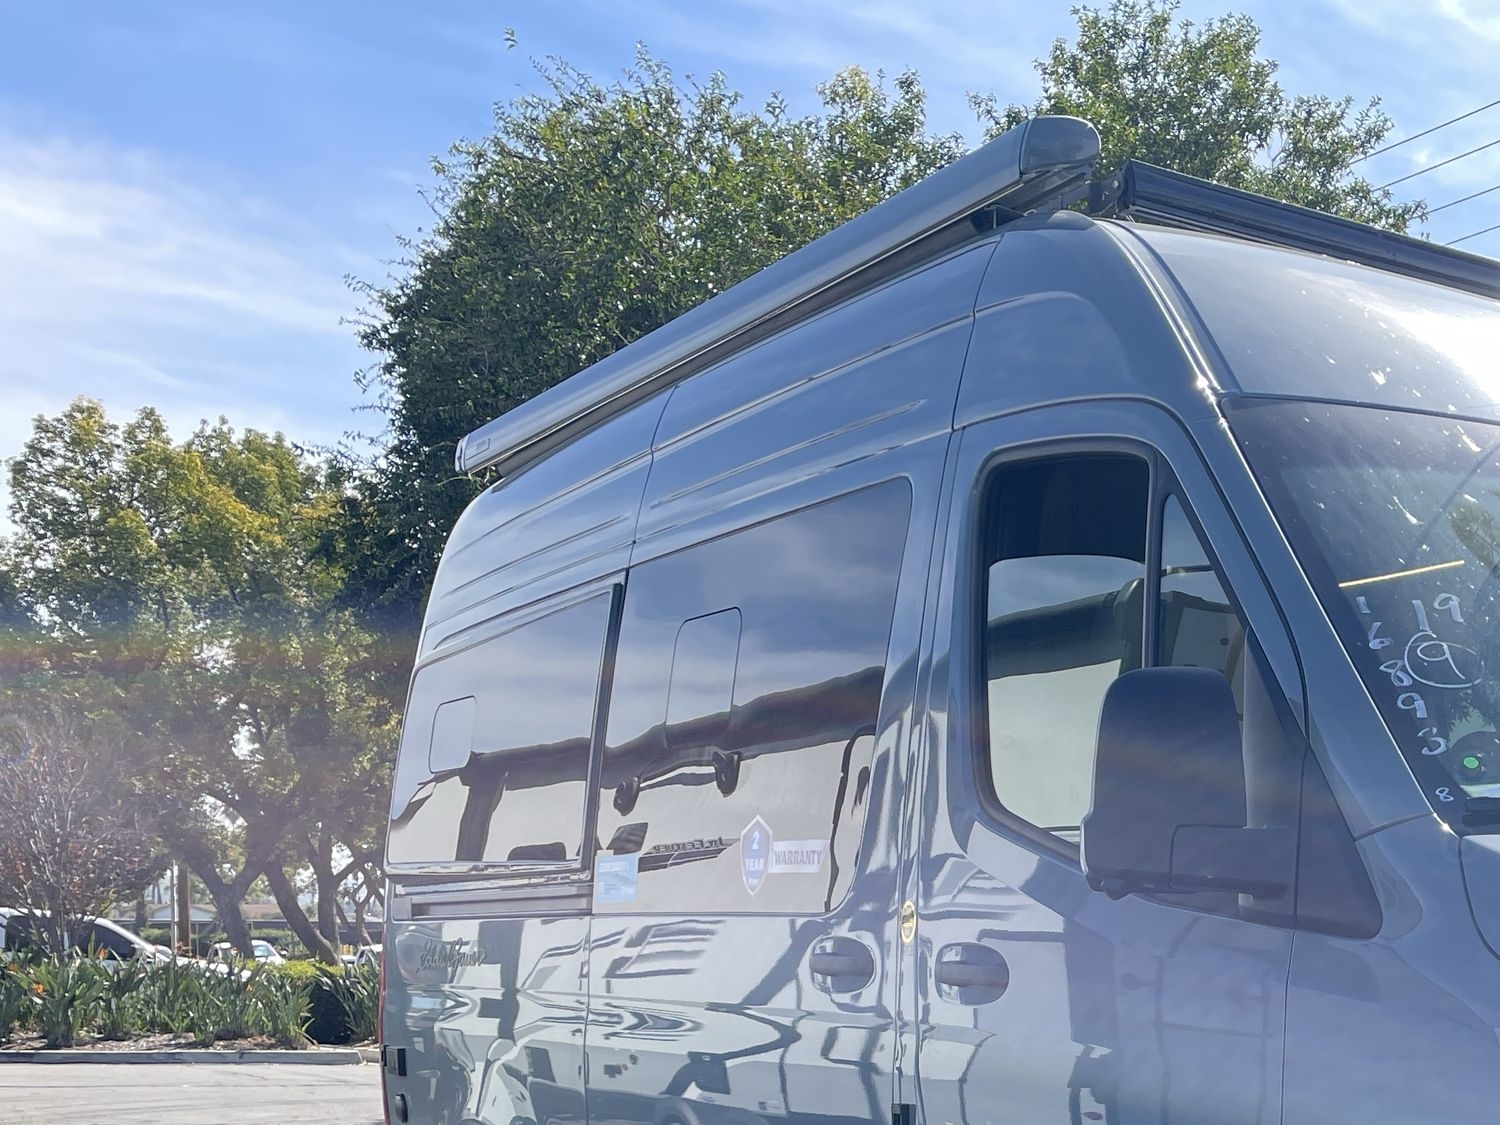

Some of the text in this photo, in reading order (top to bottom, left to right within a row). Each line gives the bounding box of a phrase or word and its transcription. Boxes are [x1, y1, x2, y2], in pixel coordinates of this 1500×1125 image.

[751, 830, 760, 850] 2
[744, 857, 765, 871] YEAR
[774, 849, 823, 865] WARRANTY
